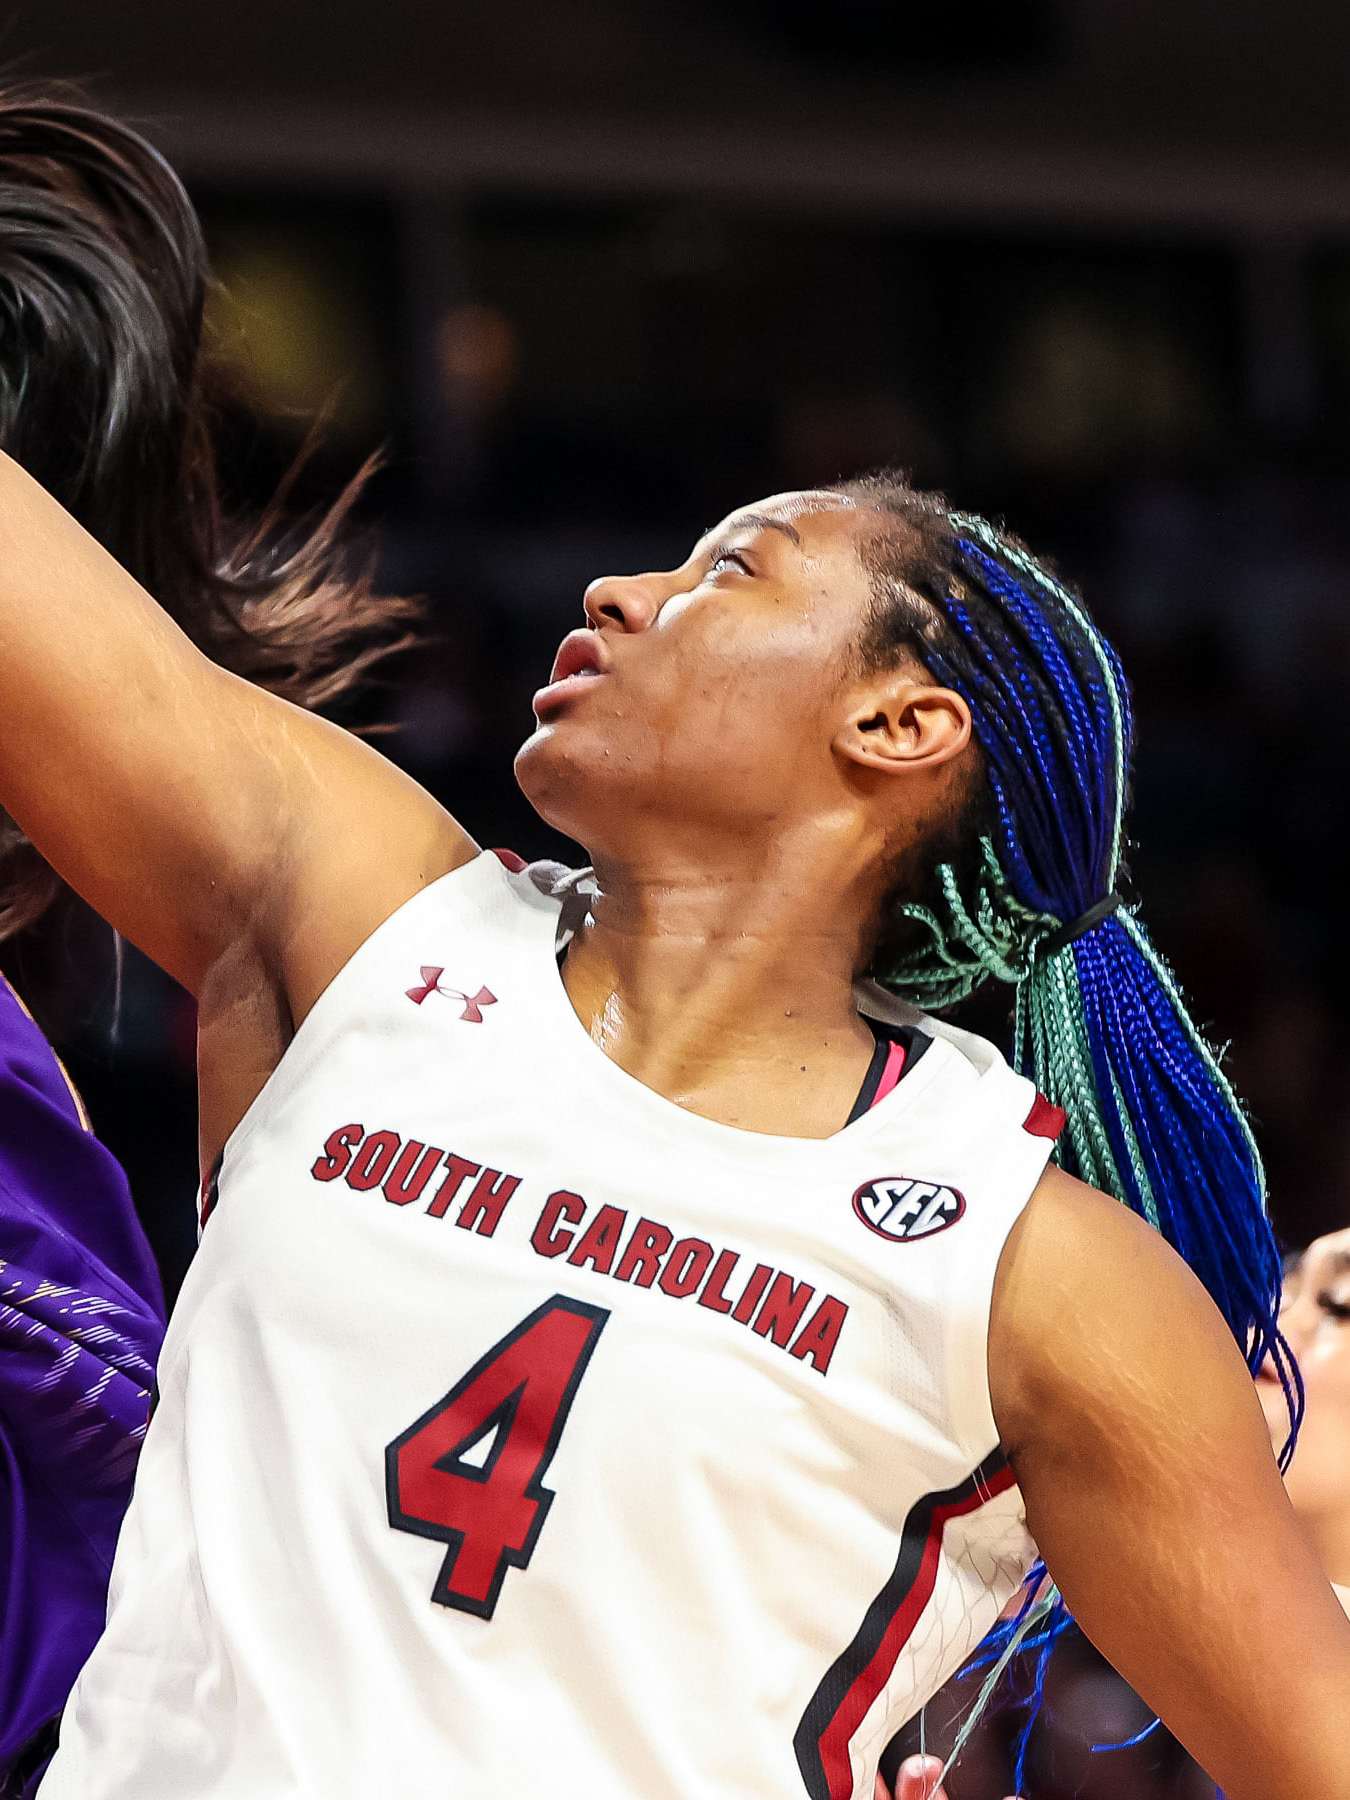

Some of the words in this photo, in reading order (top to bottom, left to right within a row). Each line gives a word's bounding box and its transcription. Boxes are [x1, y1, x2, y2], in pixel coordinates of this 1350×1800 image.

[311, 1124, 523, 1238] SOUTH
[530, 1190, 849, 1377] CAROLINA
[859, 1180, 958, 1237] SEC
[385, 1294, 611, 1621] 4
